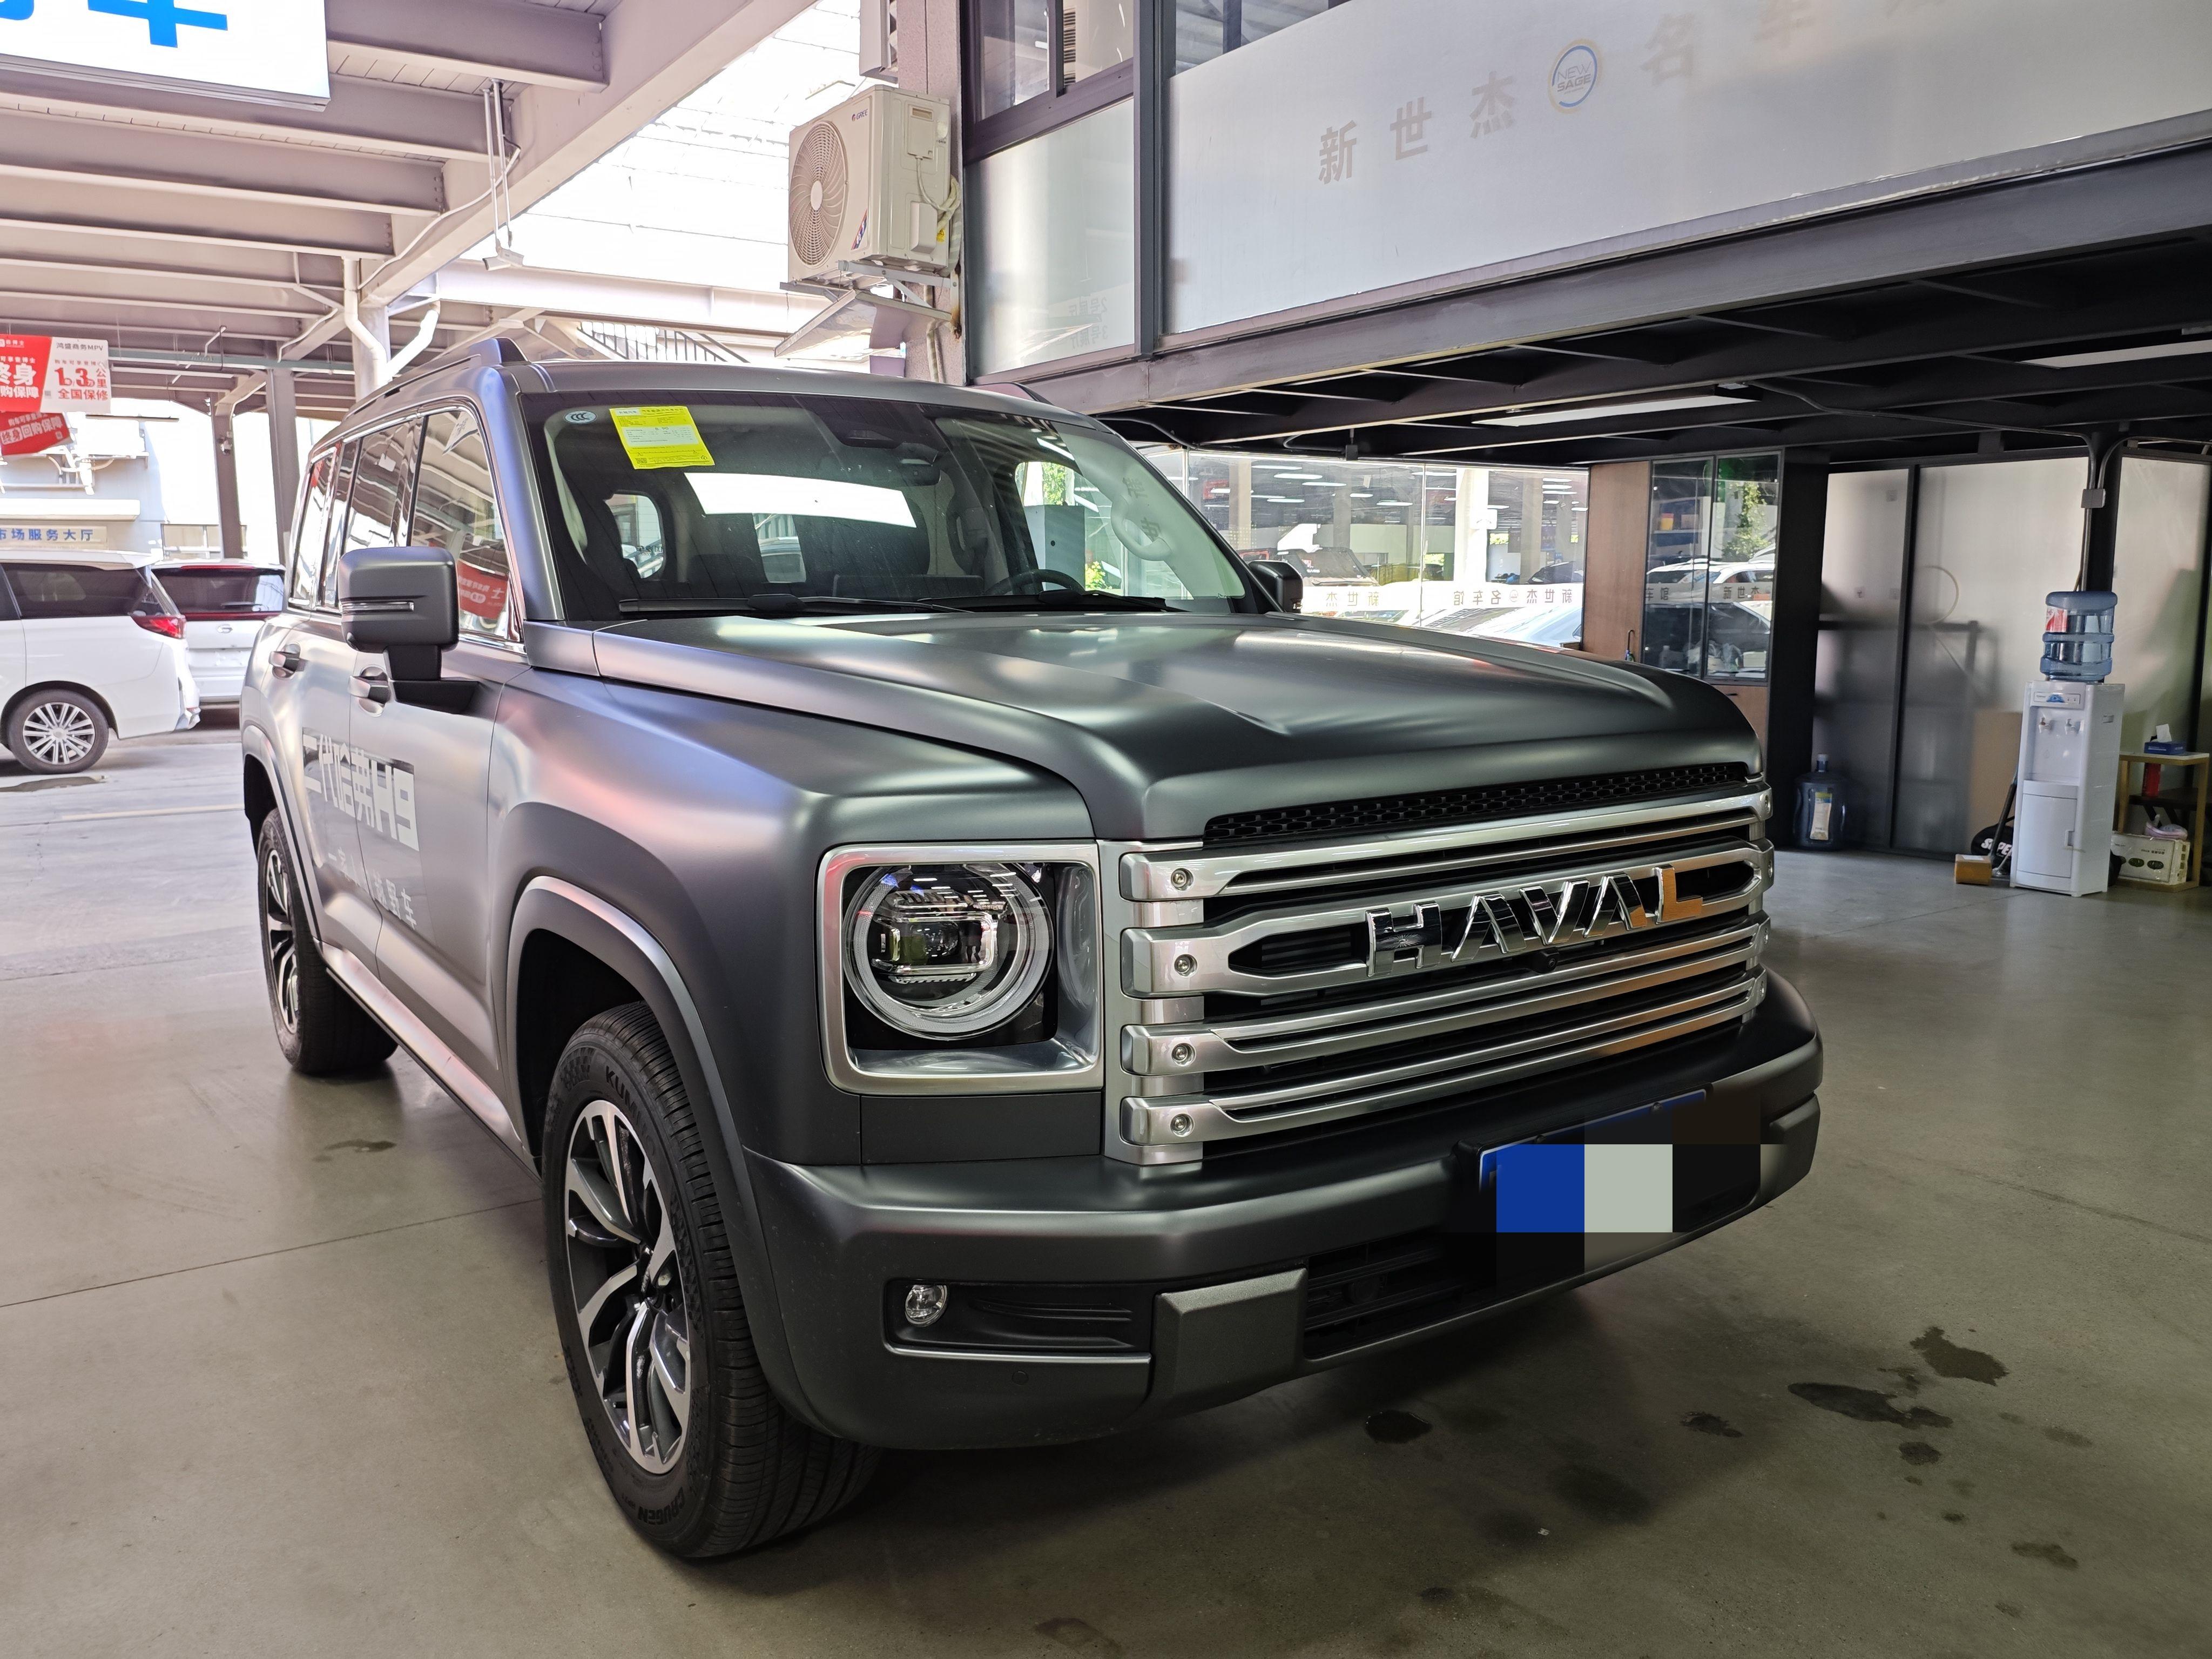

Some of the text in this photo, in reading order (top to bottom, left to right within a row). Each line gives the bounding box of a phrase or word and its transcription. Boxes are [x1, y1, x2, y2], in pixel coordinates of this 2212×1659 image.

[1557, 61, 1592, 82] NEW
[1557, 73, 1591, 92] SAGE
[856, 109, 868, 120] GREE
[1365, 864, 1703, 977] HAVAL
